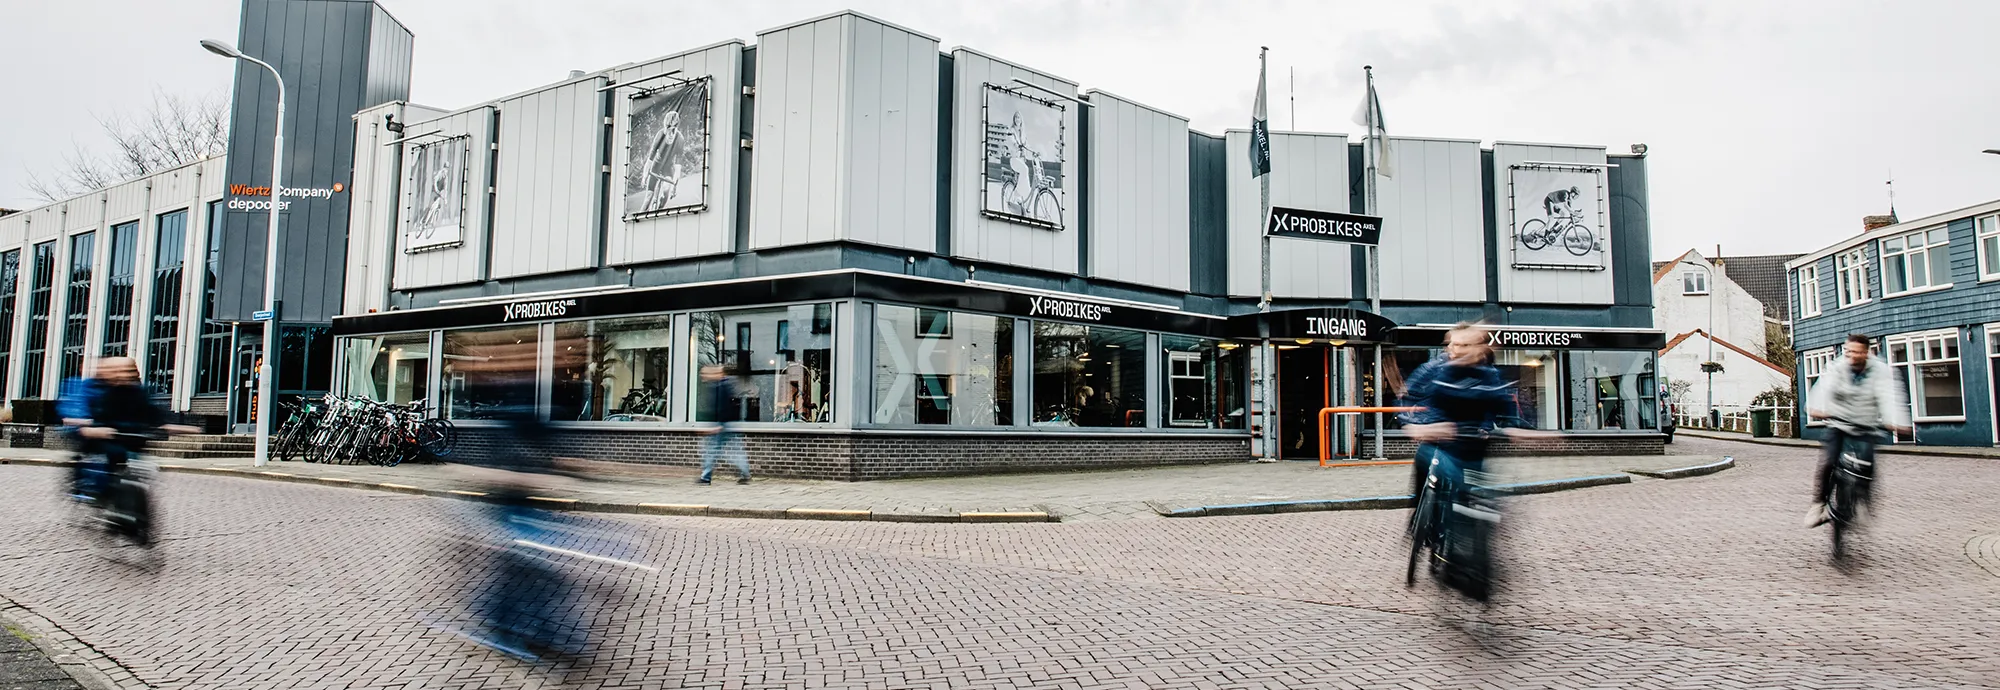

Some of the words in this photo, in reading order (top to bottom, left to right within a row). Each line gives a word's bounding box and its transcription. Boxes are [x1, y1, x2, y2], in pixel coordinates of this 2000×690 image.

[230, 183, 271, 196] Wiertz
[228, 197, 291, 212] depooer
[1290, 216, 1363, 238] PROBIKES
[515, 300, 566, 319] PROBIKES
[1044, 299, 1101, 320] PROBIKES
[1306, 316, 1367, 337] INGANG
[1503, 332, 1571, 346] PROBIKES
